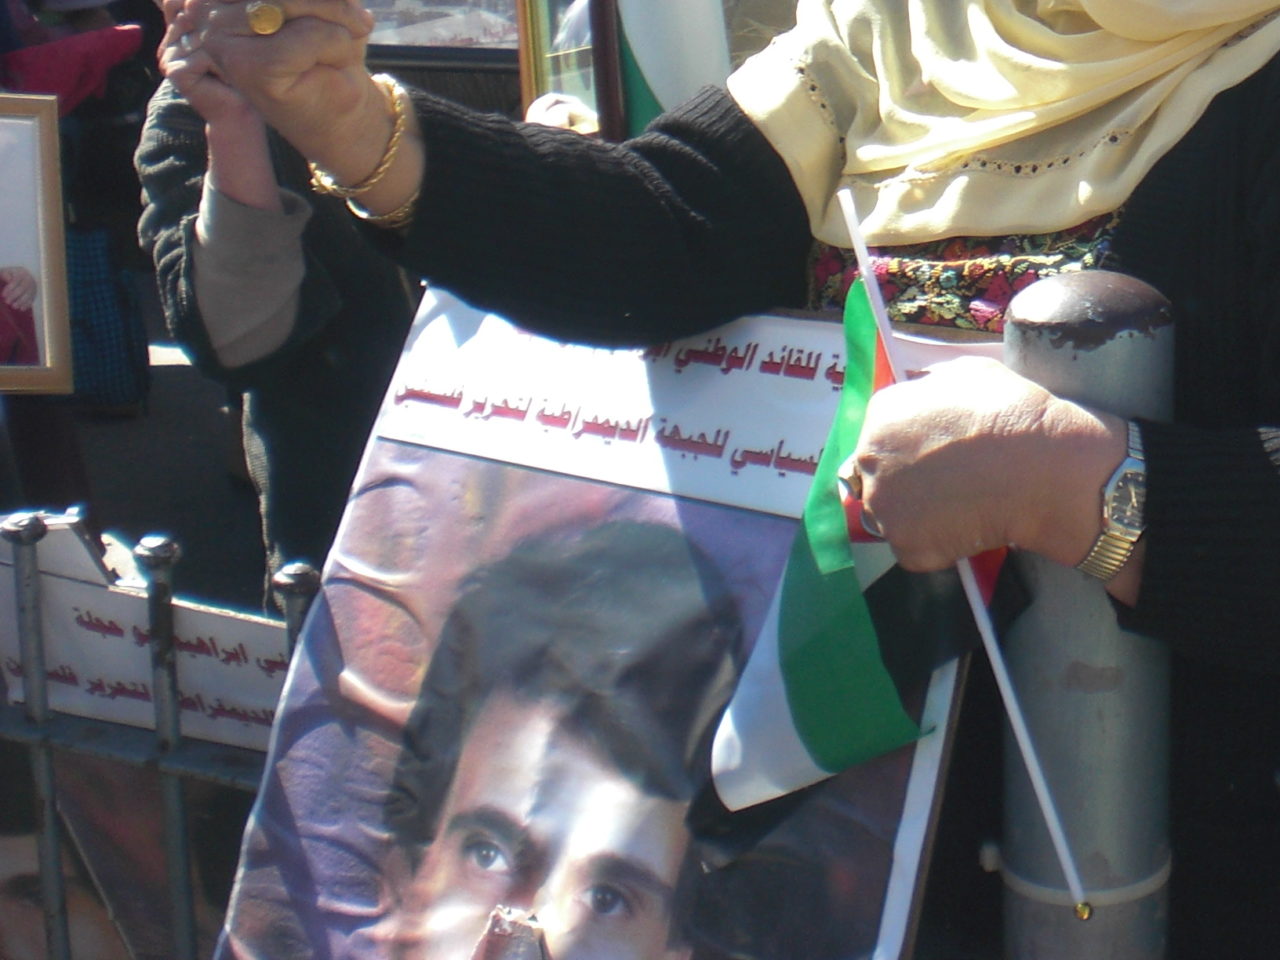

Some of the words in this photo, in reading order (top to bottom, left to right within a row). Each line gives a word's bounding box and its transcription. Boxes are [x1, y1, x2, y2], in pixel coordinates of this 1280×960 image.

[674, 337, 760, 375] الوطني
[759, 346, 822, 381] للقائد
[654, 417, 731, 461] للجبهة
[730, 439, 826, 477] لسياسي
